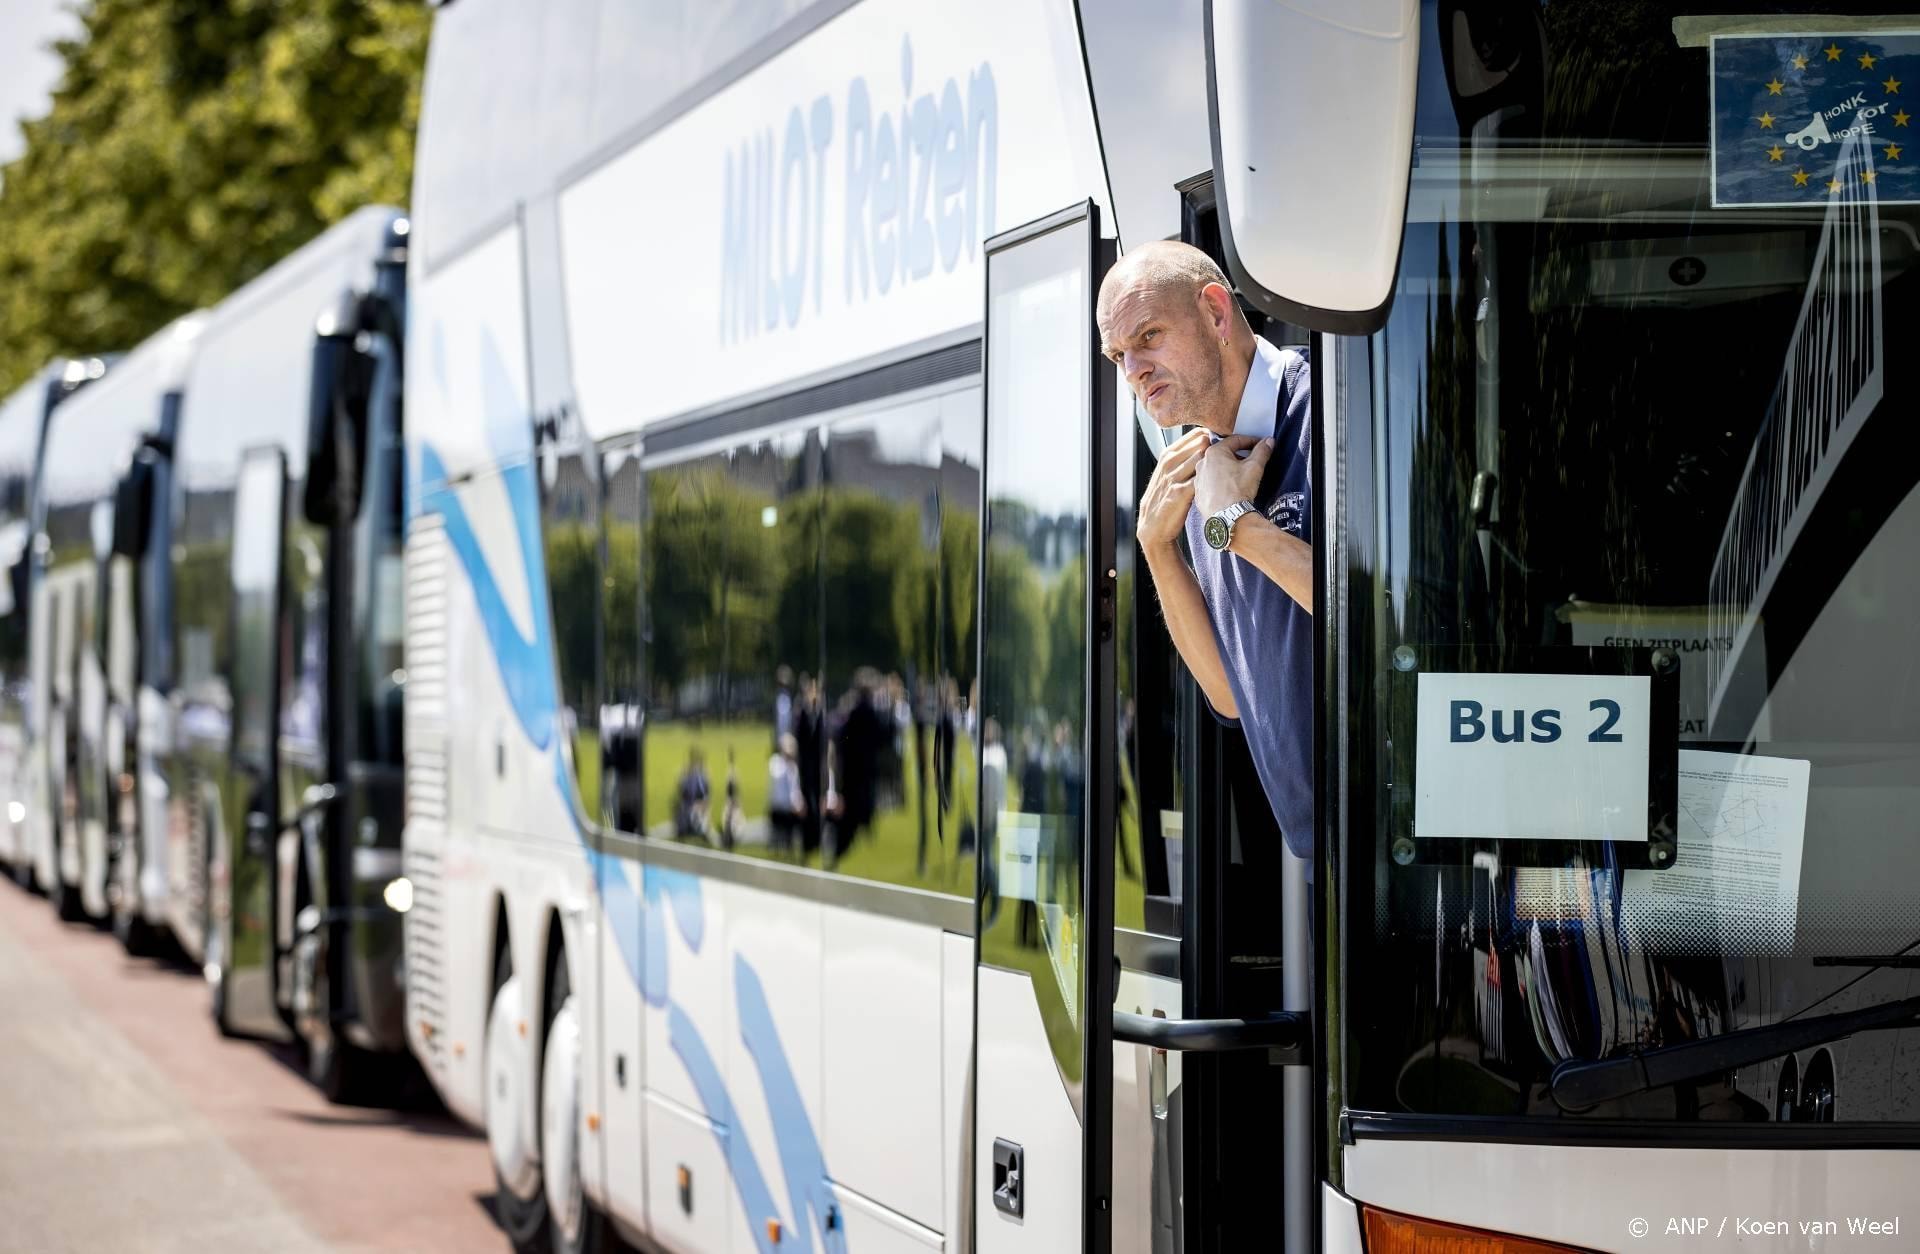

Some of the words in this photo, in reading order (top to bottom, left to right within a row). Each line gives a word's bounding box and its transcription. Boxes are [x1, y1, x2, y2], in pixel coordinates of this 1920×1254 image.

[1824, 91, 1867, 120] HONK
[1856, 102, 1889, 121] for
[1833, 123, 1876, 140] HOPE
[720, 93, 834, 350] MILOT
[845, 31, 997, 304] Reizen
[1604, 637, 1643, 647] GEEN
[1648, 638, 1733, 652] ZITPLAATS
[1450, 700, 1561, 743] Bus
[1588, 698, 1623, 743] 2
